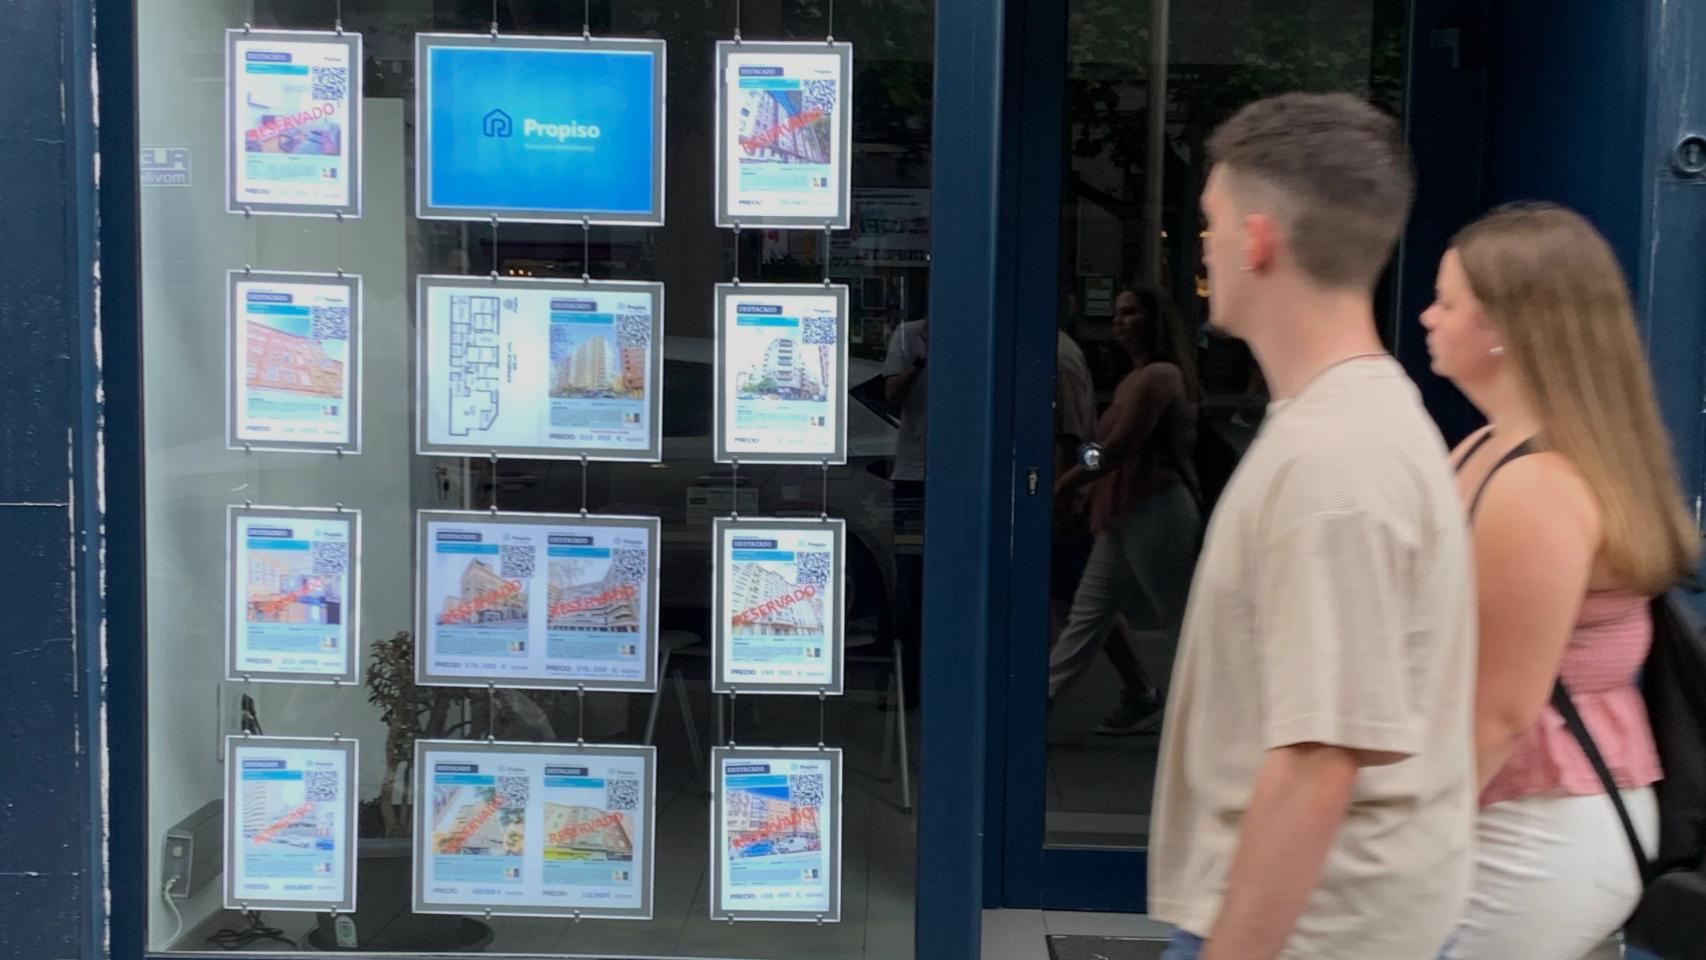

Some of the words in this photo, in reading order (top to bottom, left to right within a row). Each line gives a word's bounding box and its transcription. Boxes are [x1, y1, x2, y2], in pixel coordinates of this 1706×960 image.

[246, 102, 335, 140] RESERVADO
[523, 118, 601, 142] Propiso
[738, 306, 778, 314] DESTACADO
[734, 540, 773, 548] DESTACADO
[732, 584, 817, 627] RESERVADO
[727, 766, 765, 774] DESTACADO
[547, 811, 625, 845] RESERVADO
